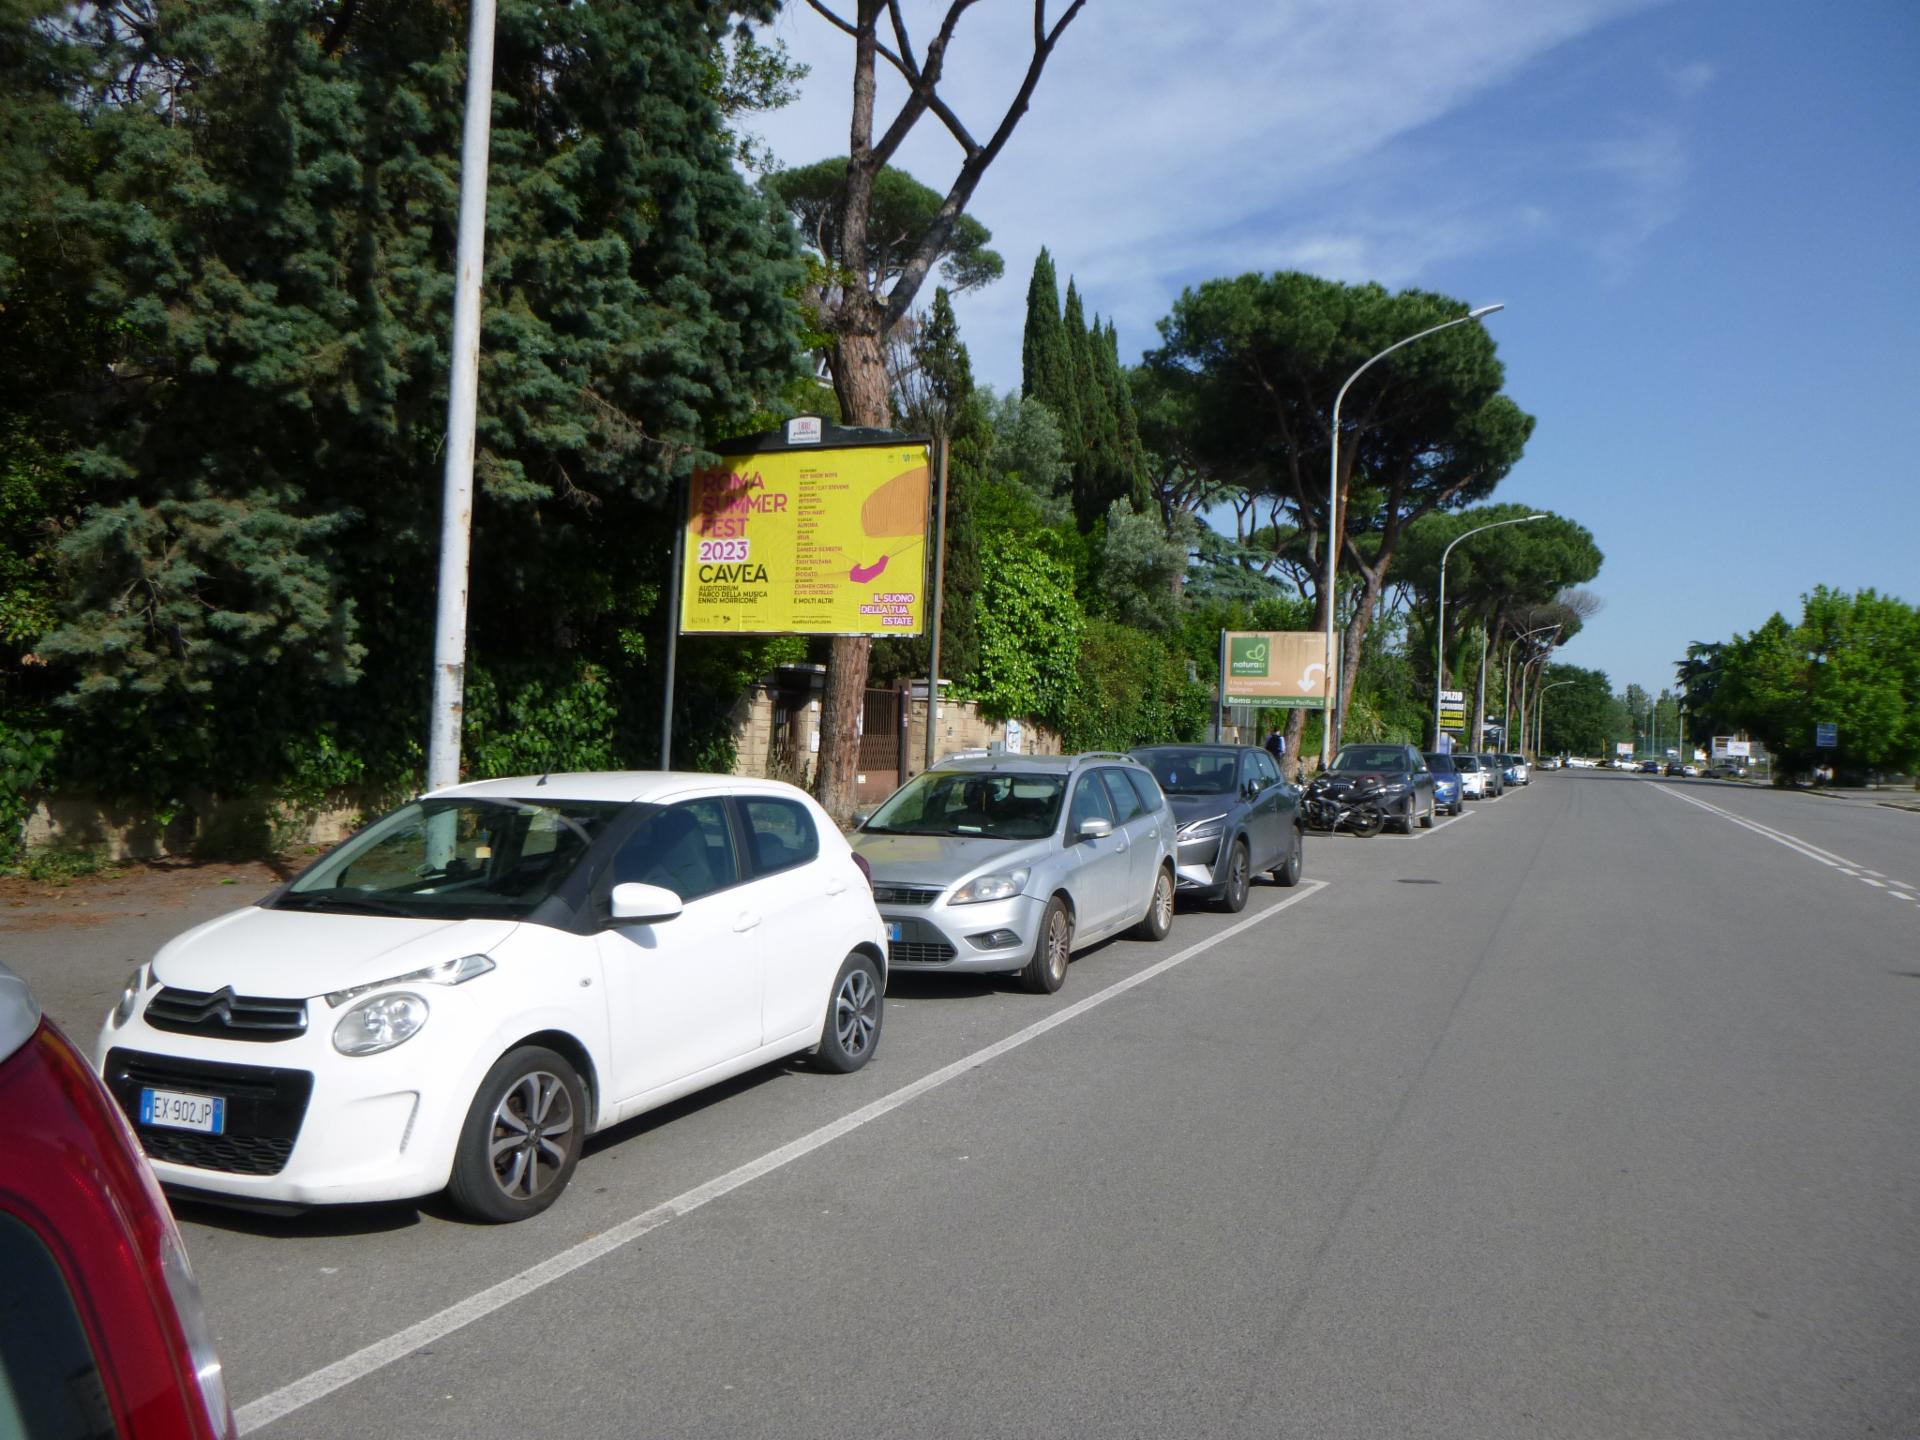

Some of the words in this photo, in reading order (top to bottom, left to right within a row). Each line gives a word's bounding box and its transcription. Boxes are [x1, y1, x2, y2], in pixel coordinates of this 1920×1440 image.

[703, 471, 764, 490] ROMA
[703, 493, 788, 514] SUMMER
[701, 518, 746, 537] FEST
[700, 541, 748, 560] 2023
[699, 564, 768, 583] CAVEA
[874, 593, 881, 603] IL
[883, 593, 914, 603] SUONO
[860, 605, 889, 614] DELLA
[890, 605, 909, 614] TUA
[882, 616, 913, 626] ESTATE
[1228, 696, 1251, 704] Roma
